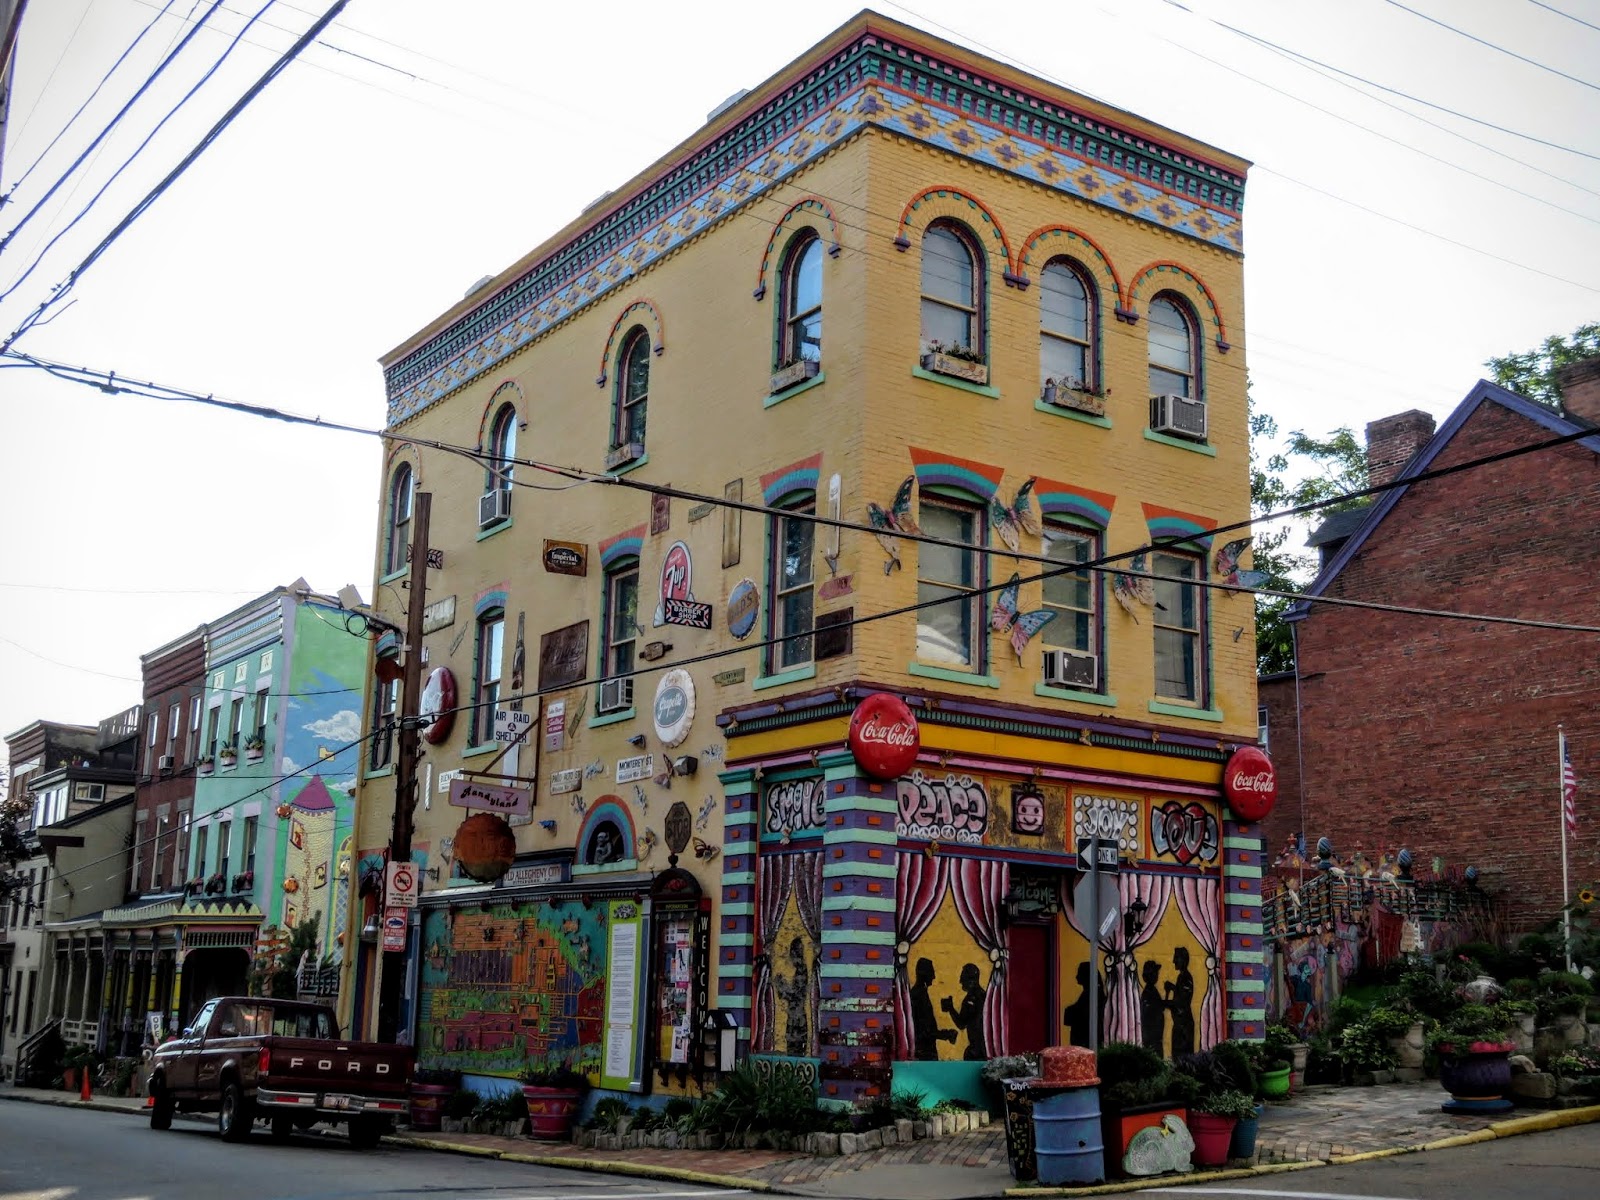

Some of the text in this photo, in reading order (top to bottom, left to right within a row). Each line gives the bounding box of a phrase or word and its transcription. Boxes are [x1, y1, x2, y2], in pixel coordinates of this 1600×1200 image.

[551, 551, 578, 562] Imperial
[665, 564, 685, 599] 7up
[673, 606, 702, 616] BARBER
[678, 612, 698, 620] SHOP
[495, 711, 530, 724] AIR RAID
[495, 731, 527, 743] SHELTER
[859, 720, 914, 746] Coca-Cola
[619, 756, 652, 771] MONTEREY ST
[1232, 770, 1274, 793] Coca-Cola
[667, 817, 689, 839] STOP
[1083, 806, 1129, 839] JOY
[515, 867, 546, 880] ALLEGHENY
[548, 865, 560, 876] CITY
[290, 1058, 389, 1073] FORD
